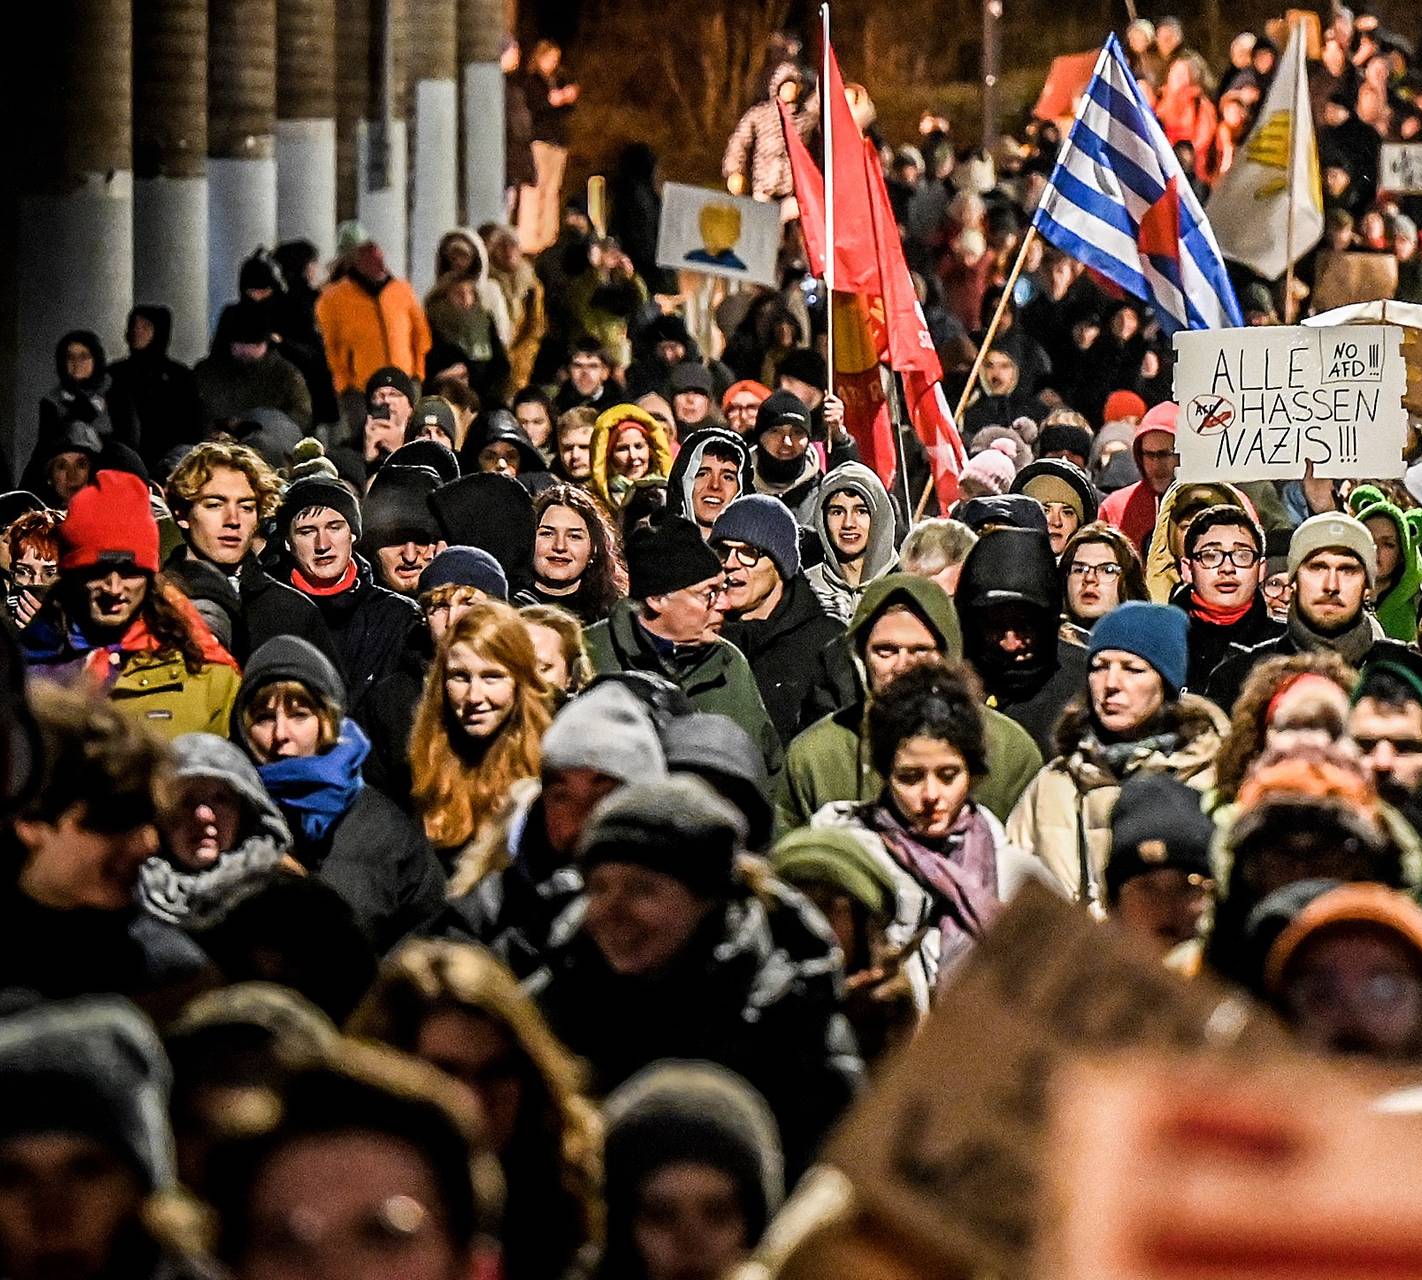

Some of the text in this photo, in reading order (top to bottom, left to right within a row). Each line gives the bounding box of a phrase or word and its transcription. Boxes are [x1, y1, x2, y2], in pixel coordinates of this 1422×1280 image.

[1333, 341, 1358, 360] NO
[1212, 347, 1309, 394] ALLE
[1328, 360, 1366, 378] AFD
[1241, 388, 1380, 425] HASSEN
